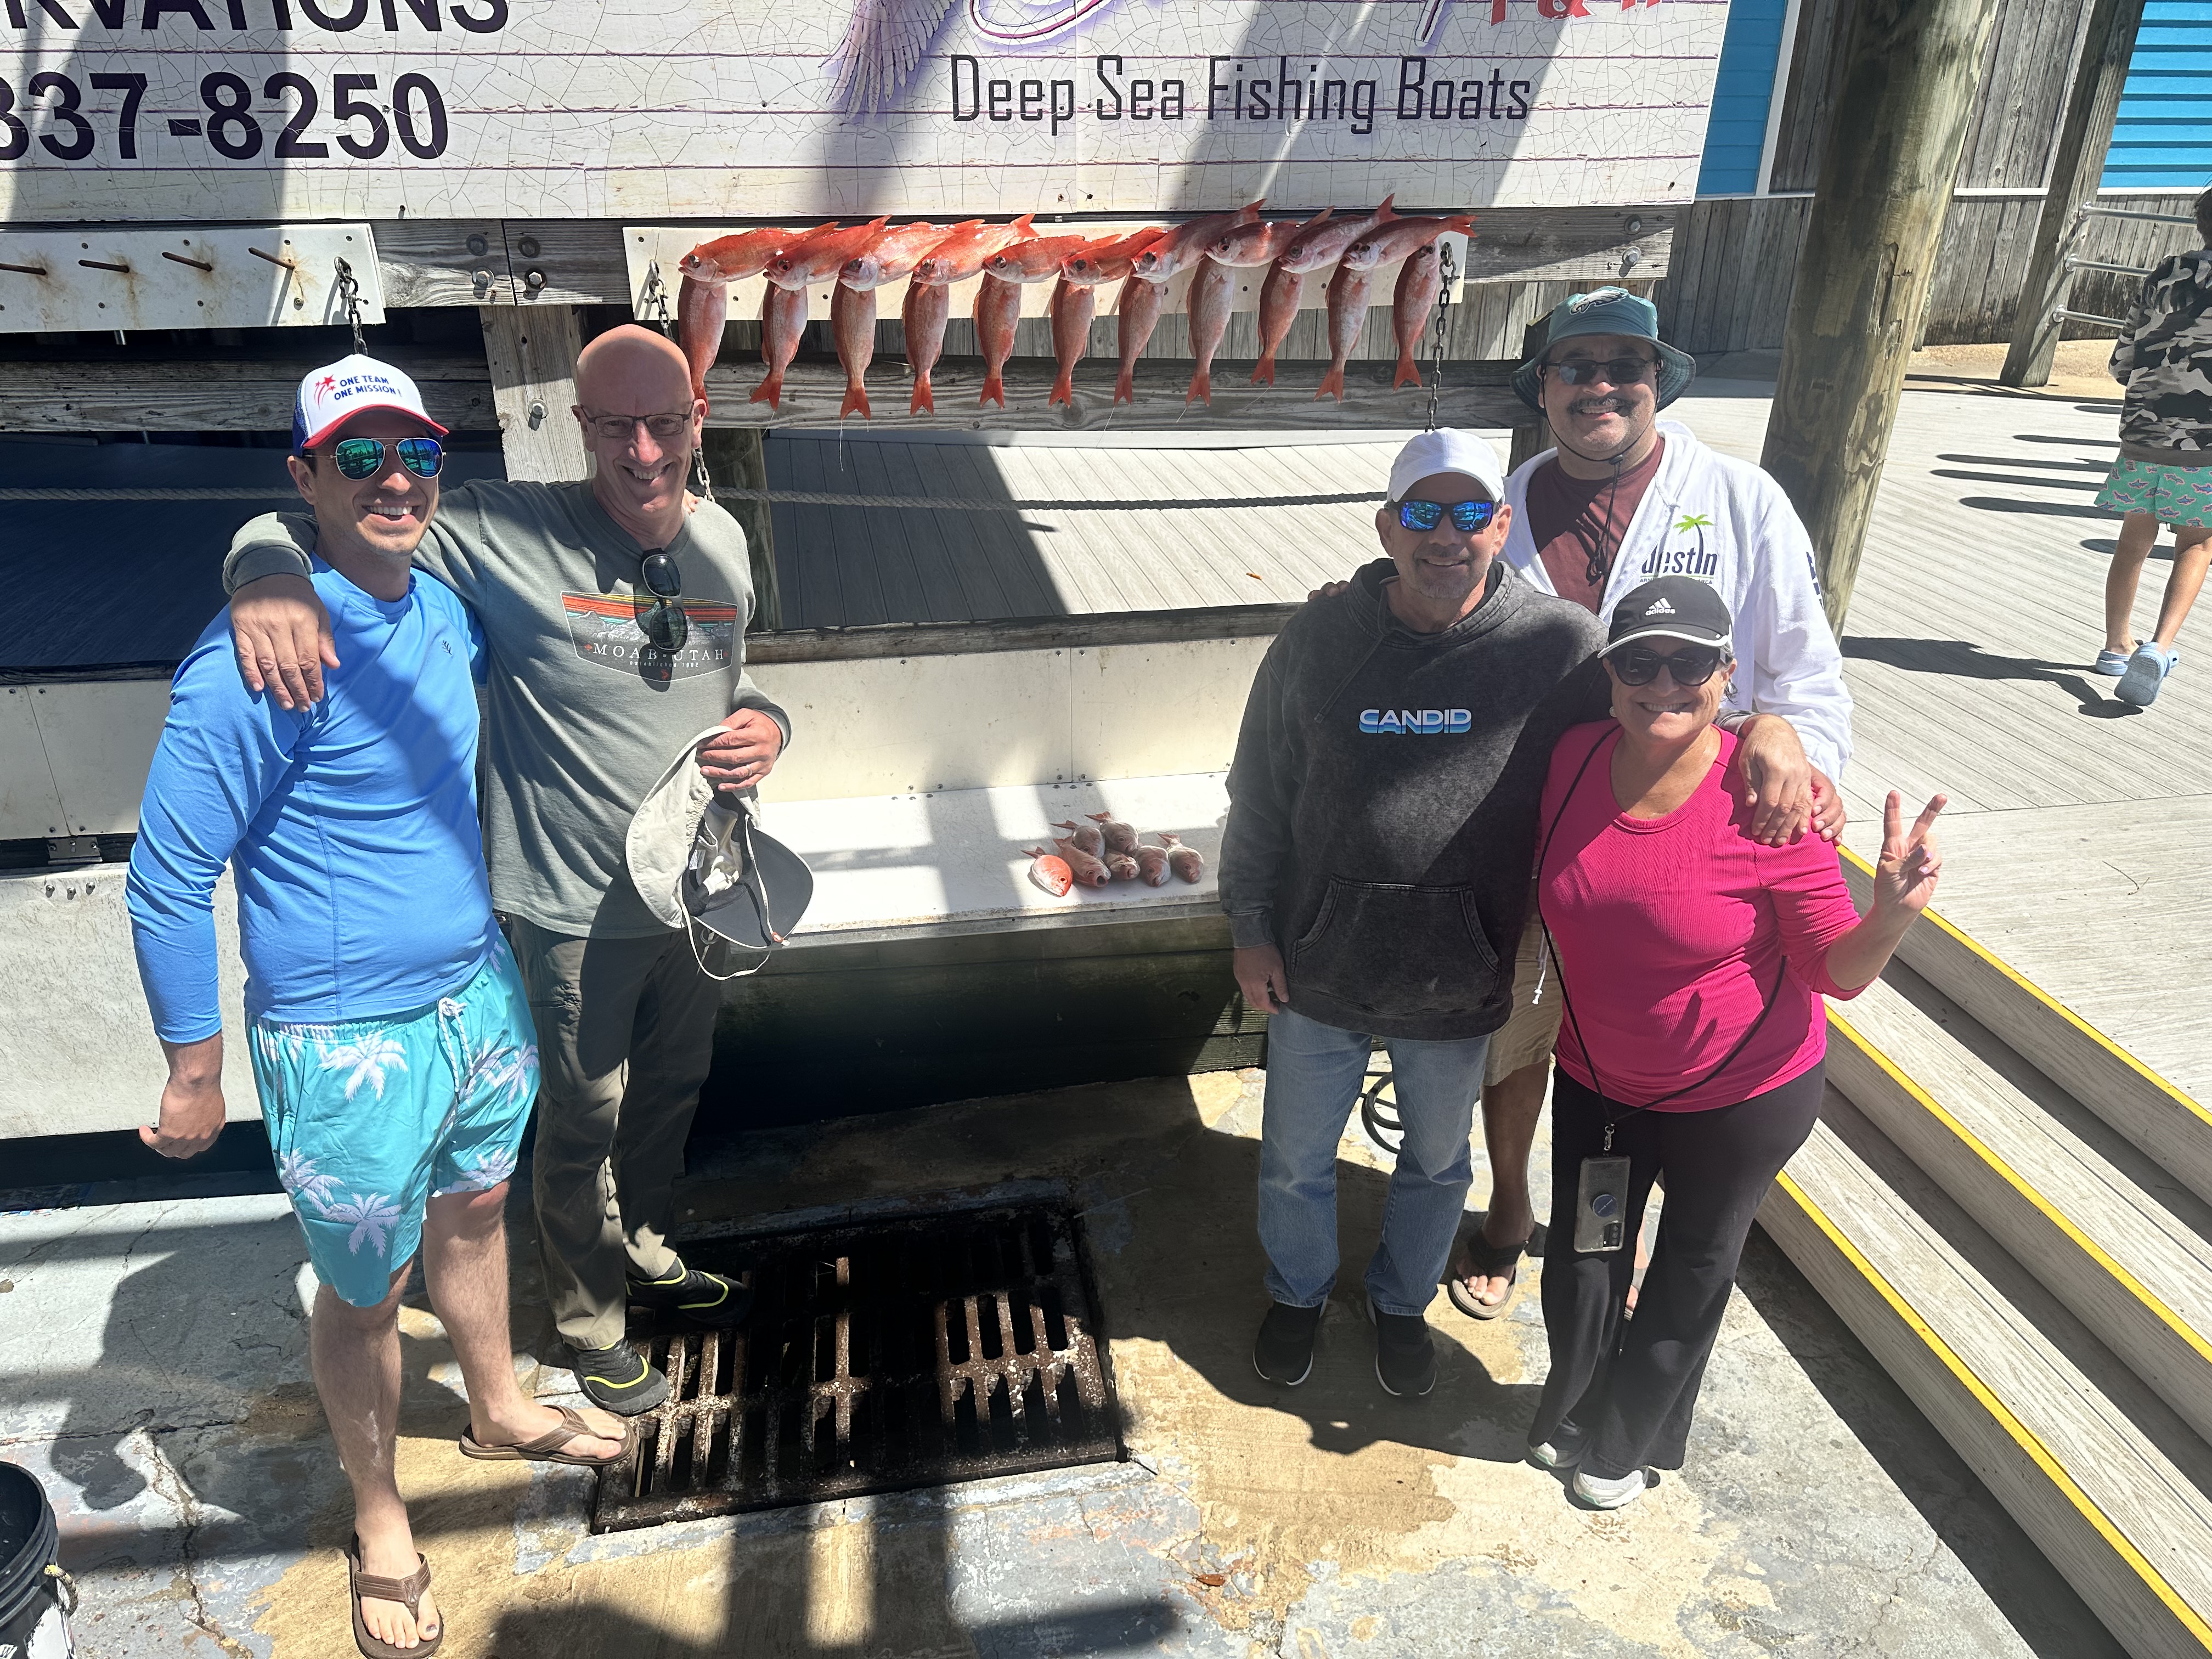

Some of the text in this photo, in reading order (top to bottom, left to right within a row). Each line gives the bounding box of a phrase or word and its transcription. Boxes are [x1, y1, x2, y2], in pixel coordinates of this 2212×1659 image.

[951, 54, 1531, 136] Deep Sea Fishing Boats
[340, 375, 390, 387] ONE TEAM
[334, 387, 353, 400] ONE
[355, 385, 396, 394] MISSION
[1645, 607, 1675, 616] adidas
[593, 642, 724, 661] MOAB UTAH
[1359, 709, 1472, 734] CANDID
